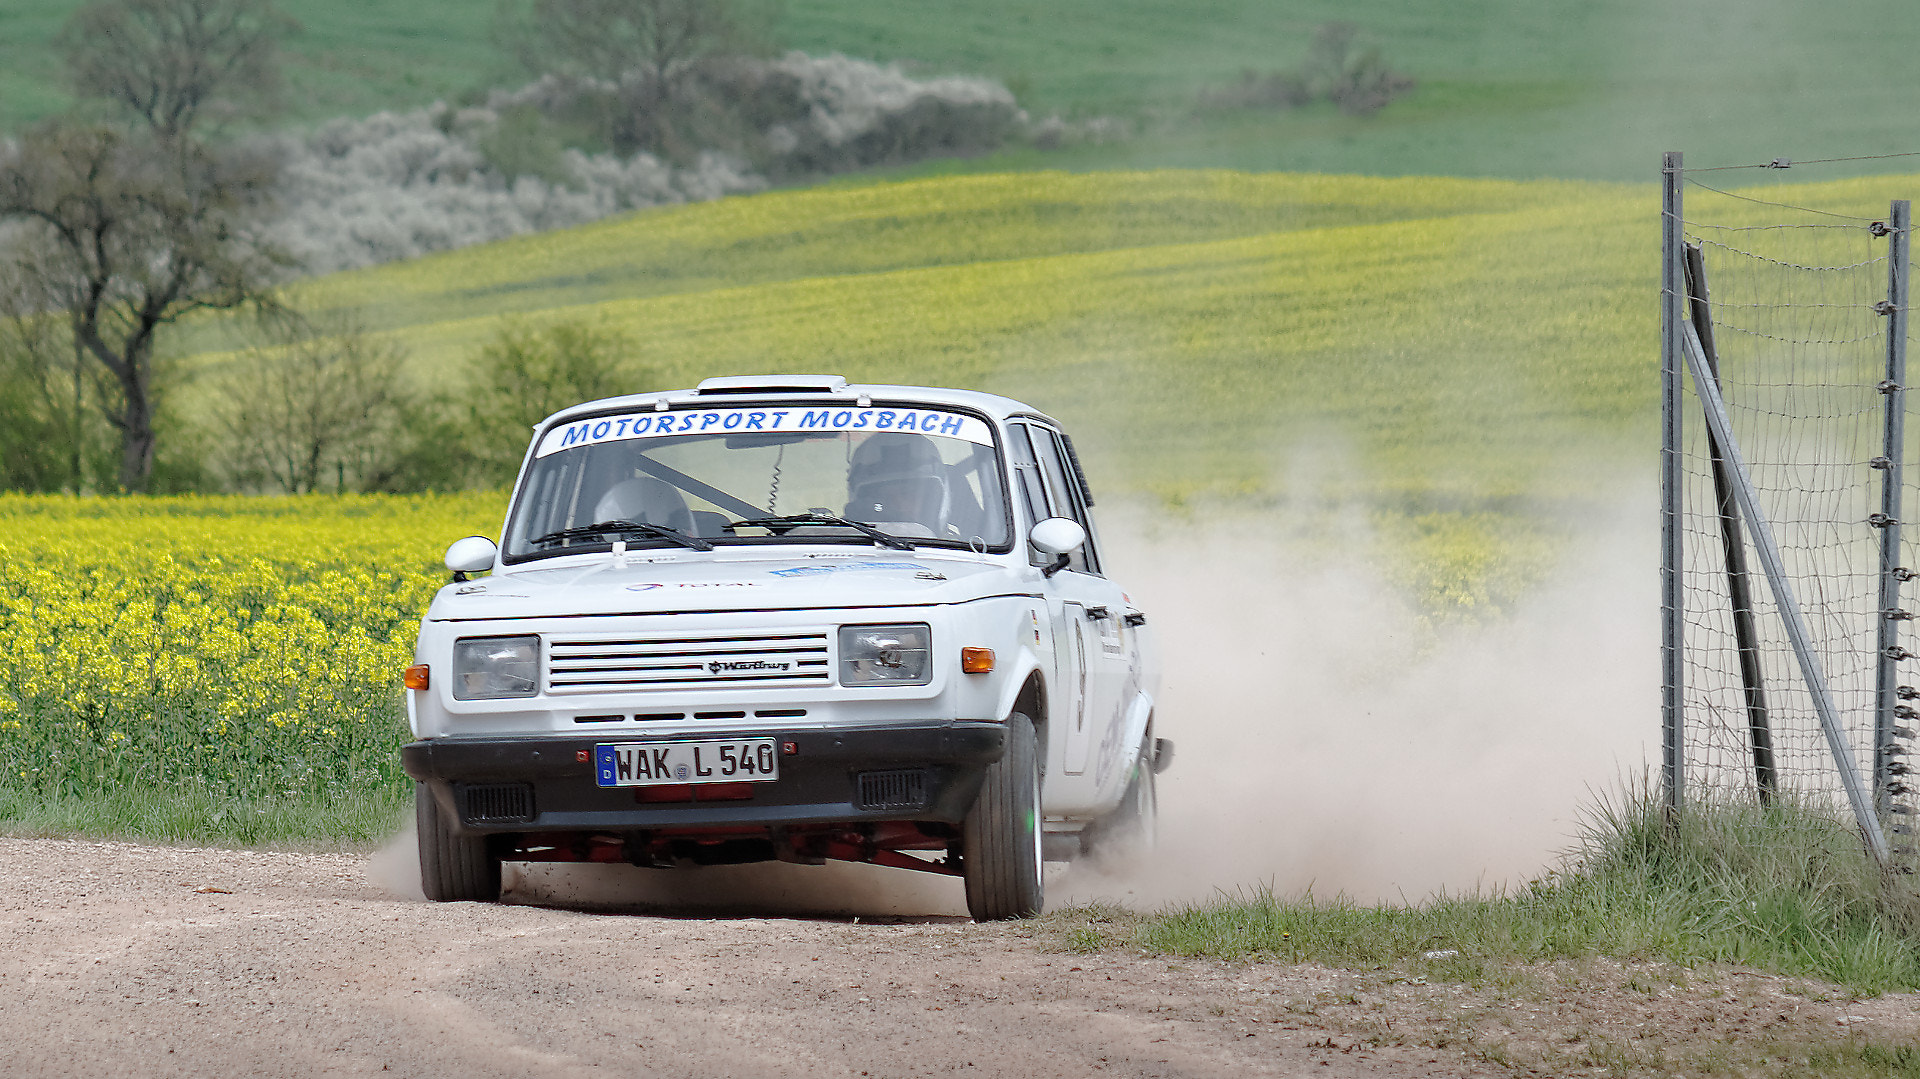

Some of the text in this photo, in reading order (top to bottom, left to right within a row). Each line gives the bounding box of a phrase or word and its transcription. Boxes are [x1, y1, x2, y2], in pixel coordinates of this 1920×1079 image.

[561, 411, 964, 447] MOTORSPORT MOSBACH
[603, 769, 612, 779] D
[616, 744, 774, 781] WAK L 540
